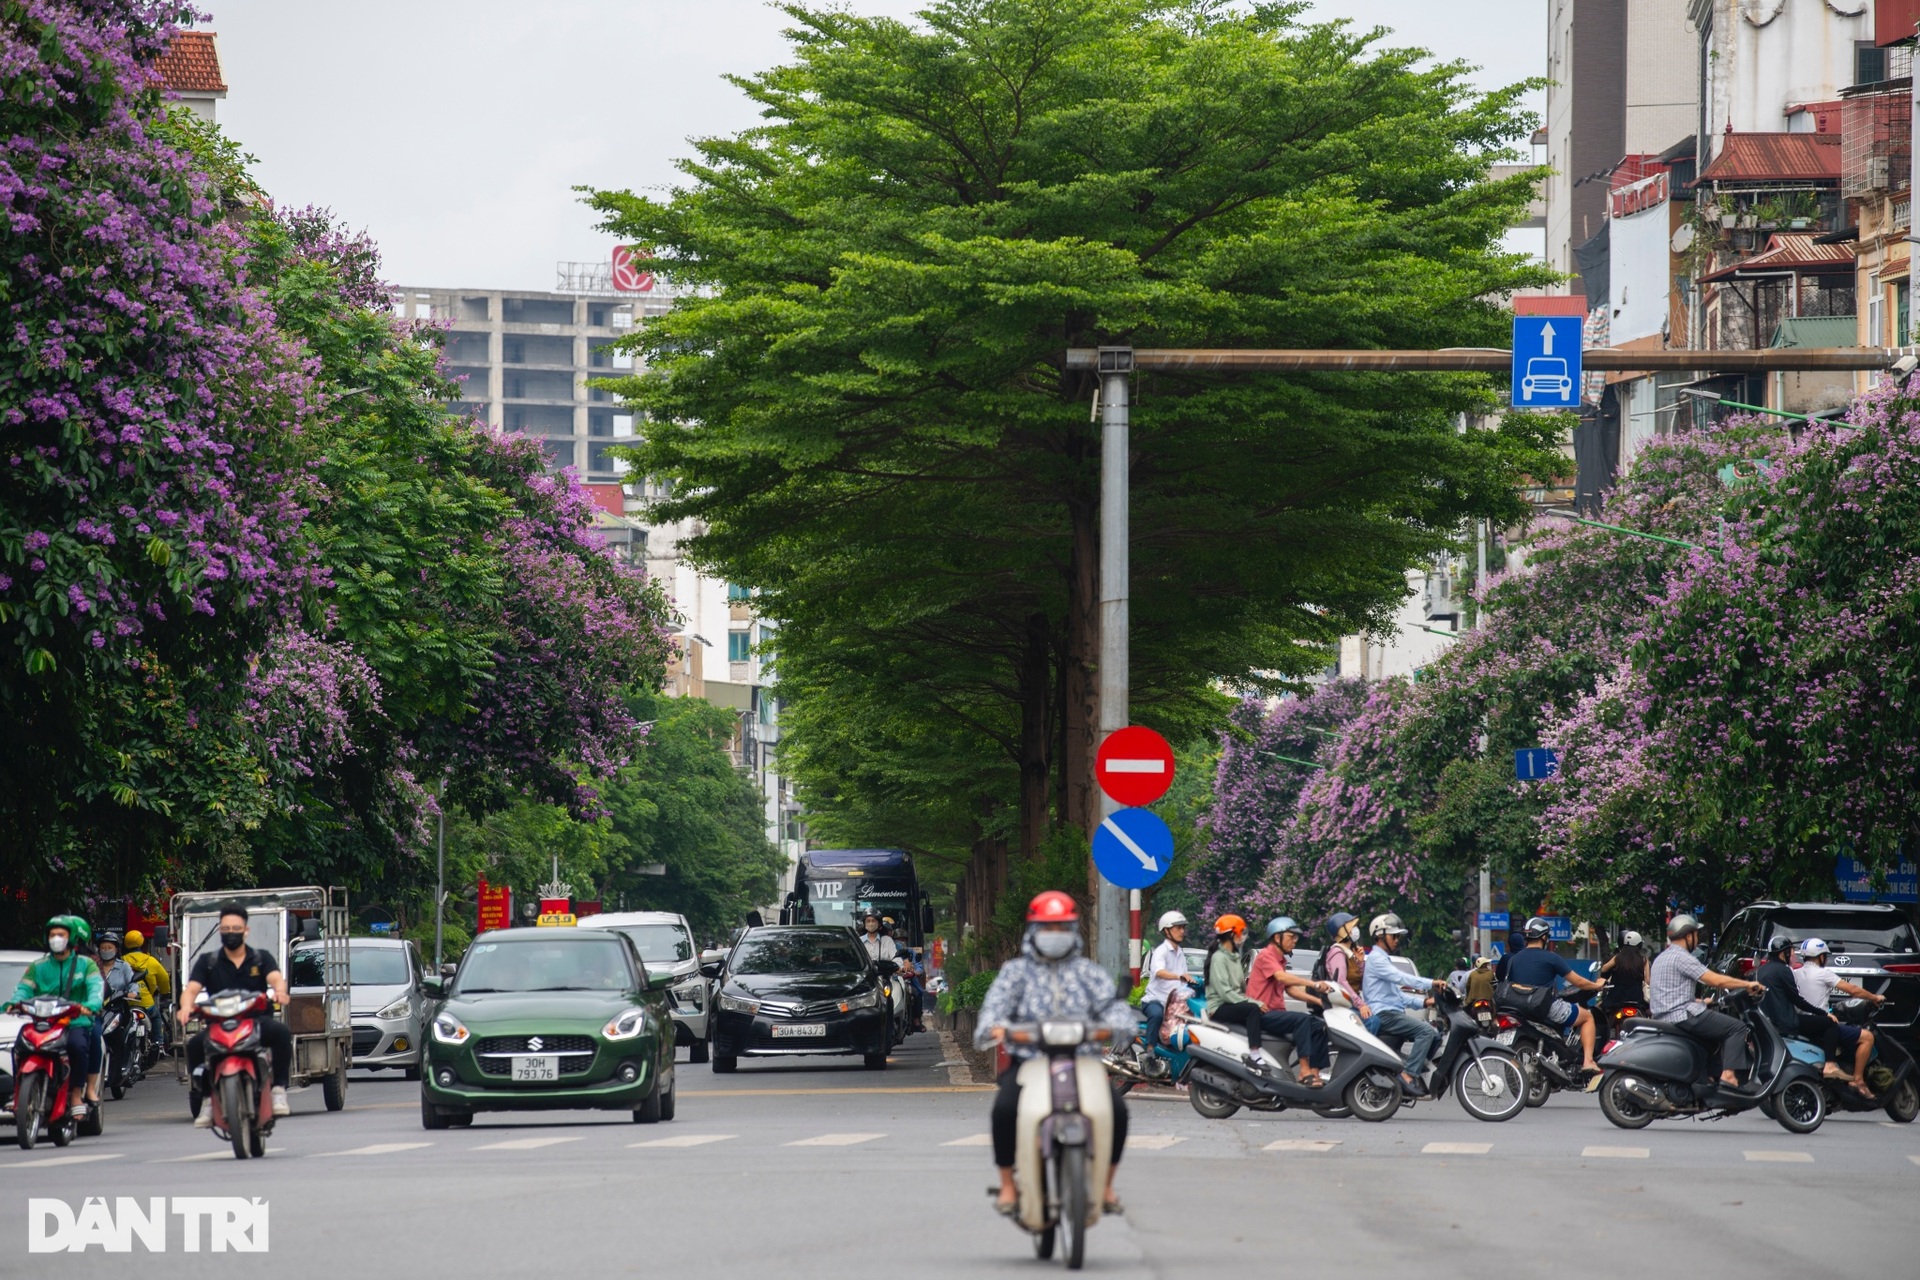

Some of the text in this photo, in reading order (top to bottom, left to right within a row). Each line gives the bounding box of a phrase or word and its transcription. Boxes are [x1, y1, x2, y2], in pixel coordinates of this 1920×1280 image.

[814, 881, 908, 899] VIP Limousine
[525, 1058, 546, 1069] 30H
[517, 1069, 553, 1080] 793.76
